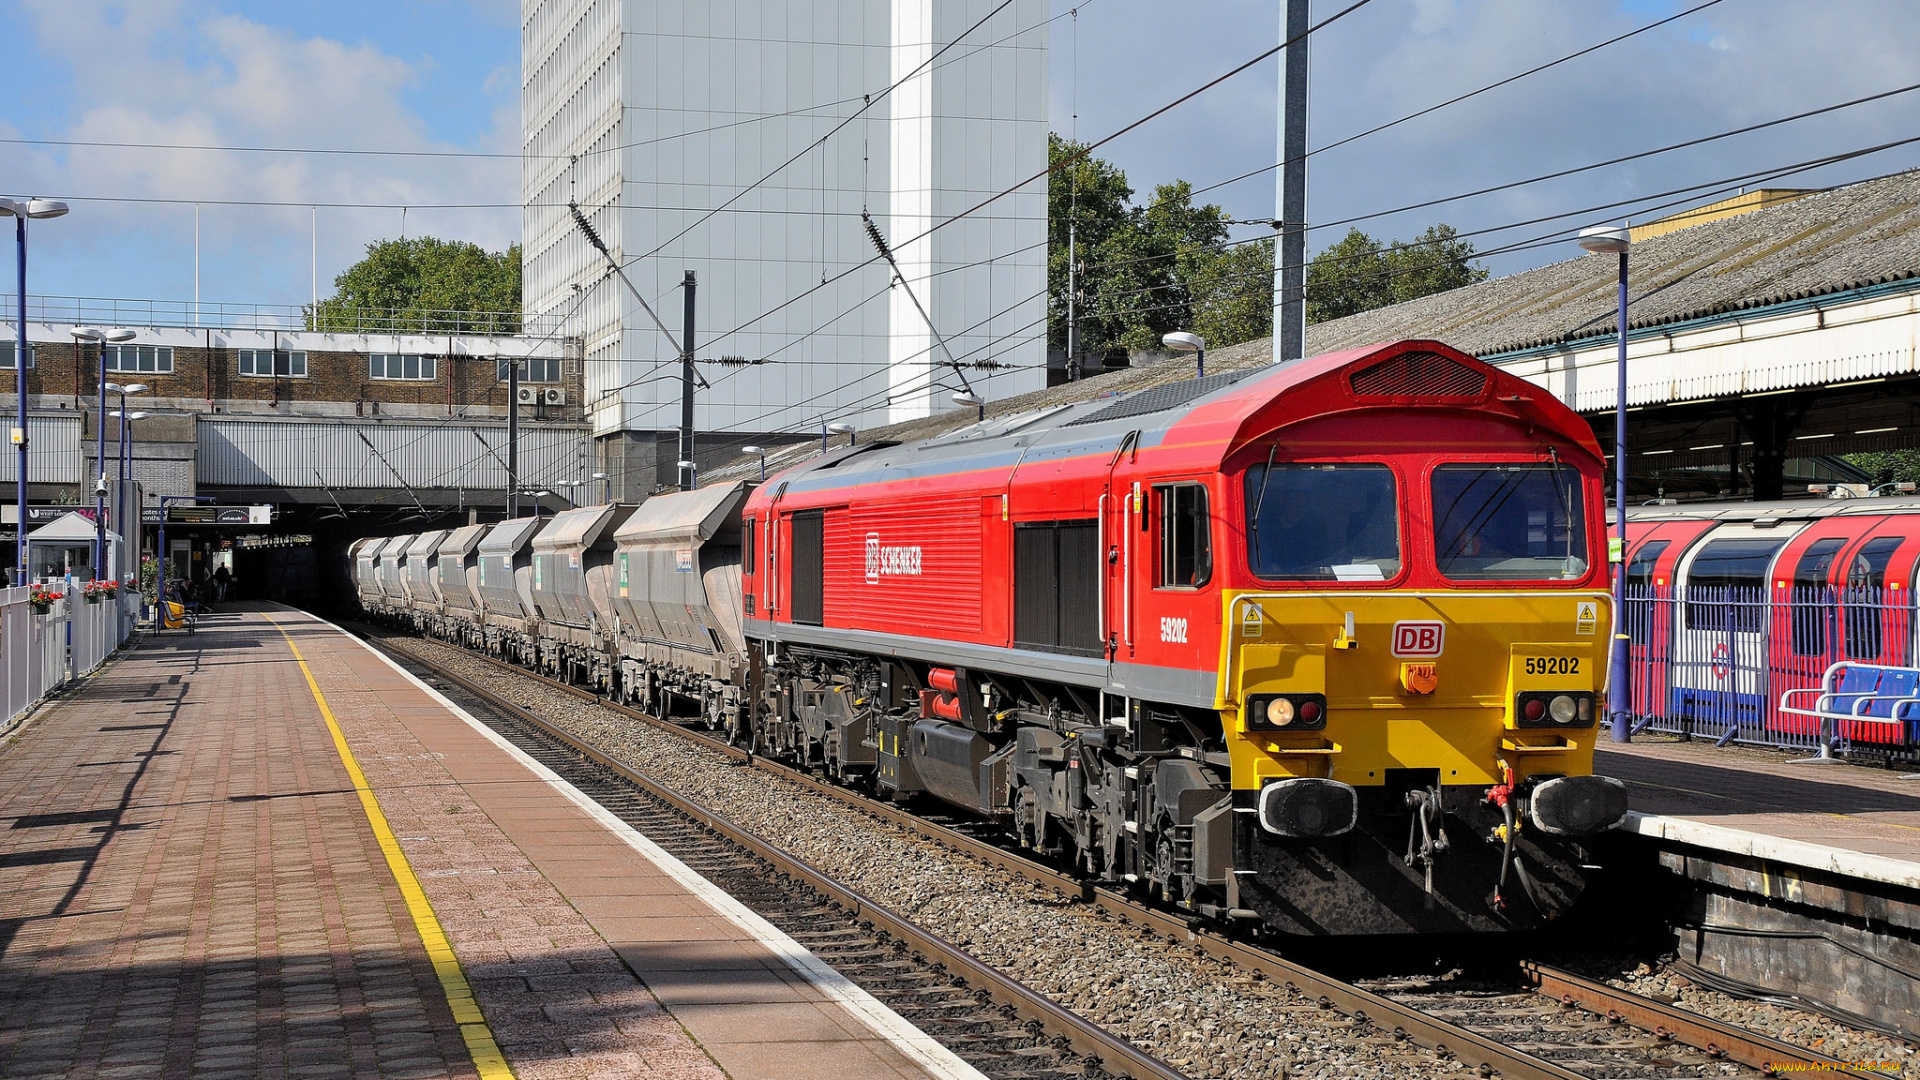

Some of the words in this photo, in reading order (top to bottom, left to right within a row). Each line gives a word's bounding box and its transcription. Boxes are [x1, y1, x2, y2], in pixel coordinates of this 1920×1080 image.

[867, 539, 878, 577] DB
[881, 546, 922, 575] SCHENKER
[1160, 616, 1188, 644] 59202
[1400, 628, 1436, 650] DB
[1526, 657, 1580, 675] 59202
